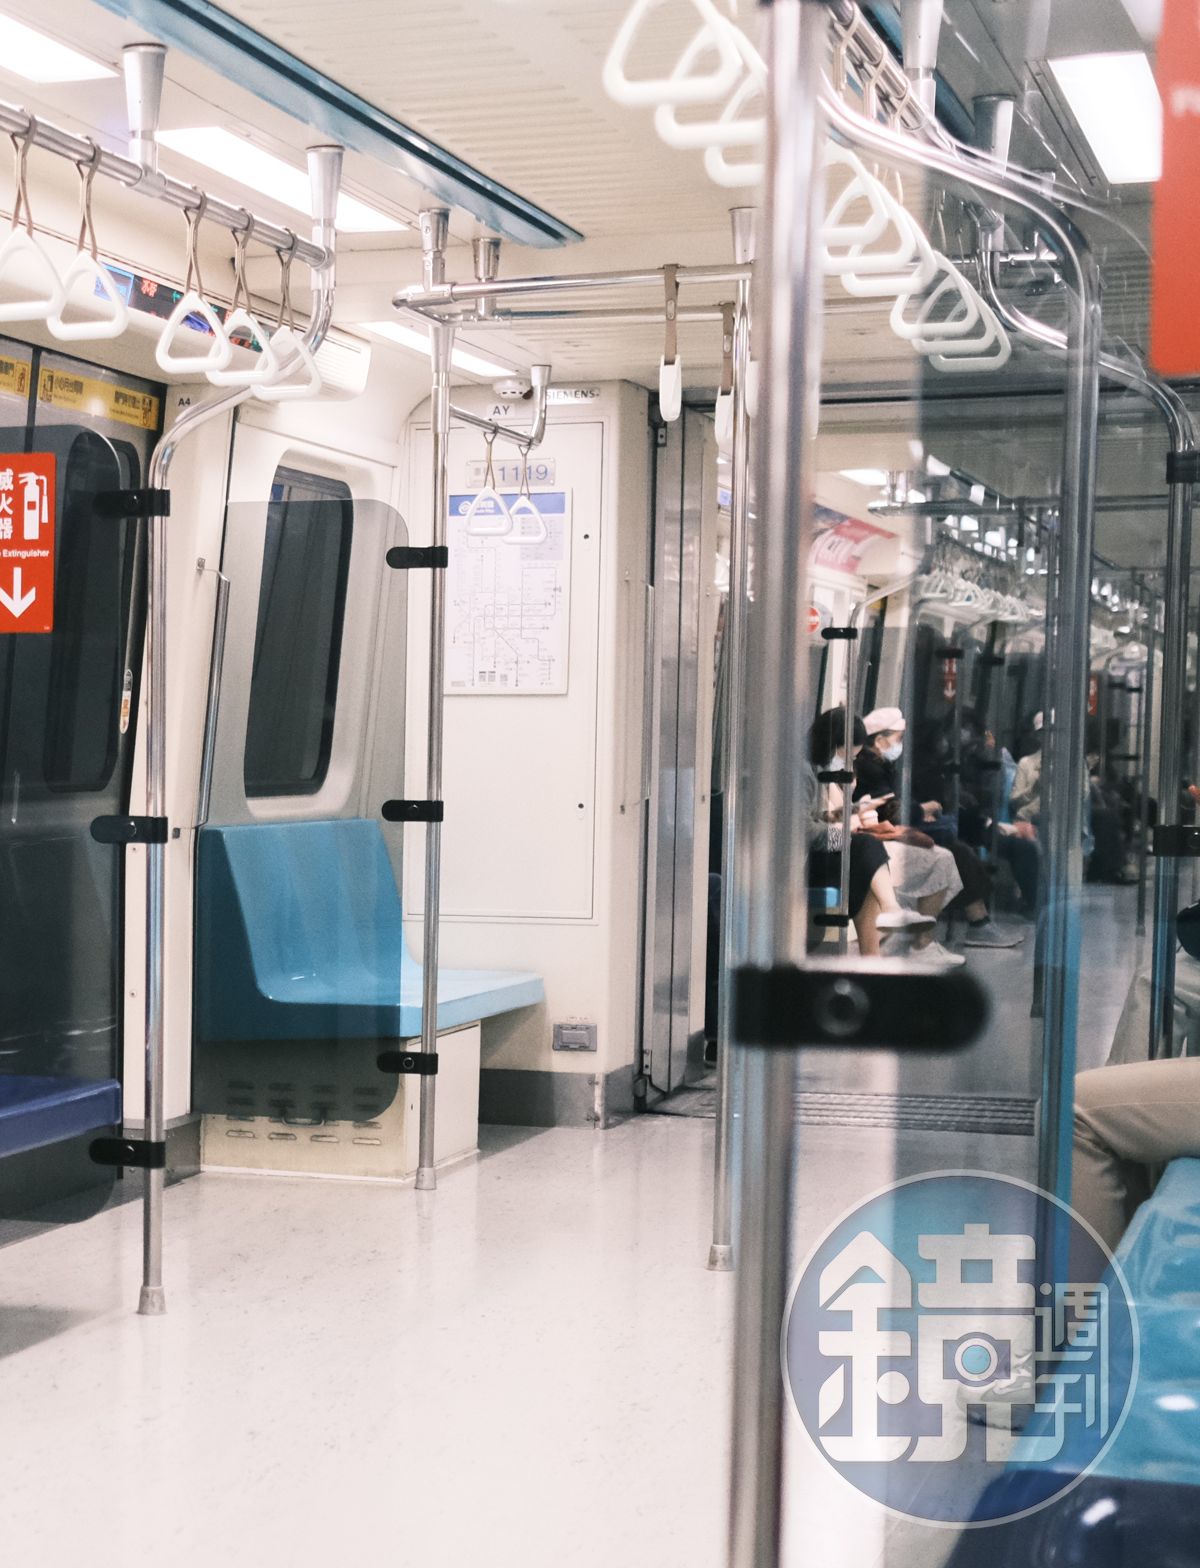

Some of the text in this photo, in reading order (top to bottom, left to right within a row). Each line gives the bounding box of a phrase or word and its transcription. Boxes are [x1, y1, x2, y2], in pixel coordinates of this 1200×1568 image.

[492, 405, 510, 416] AY
[498, 464, 549, 481] 1119
[2, 549, 50, 559] Extinguisher
